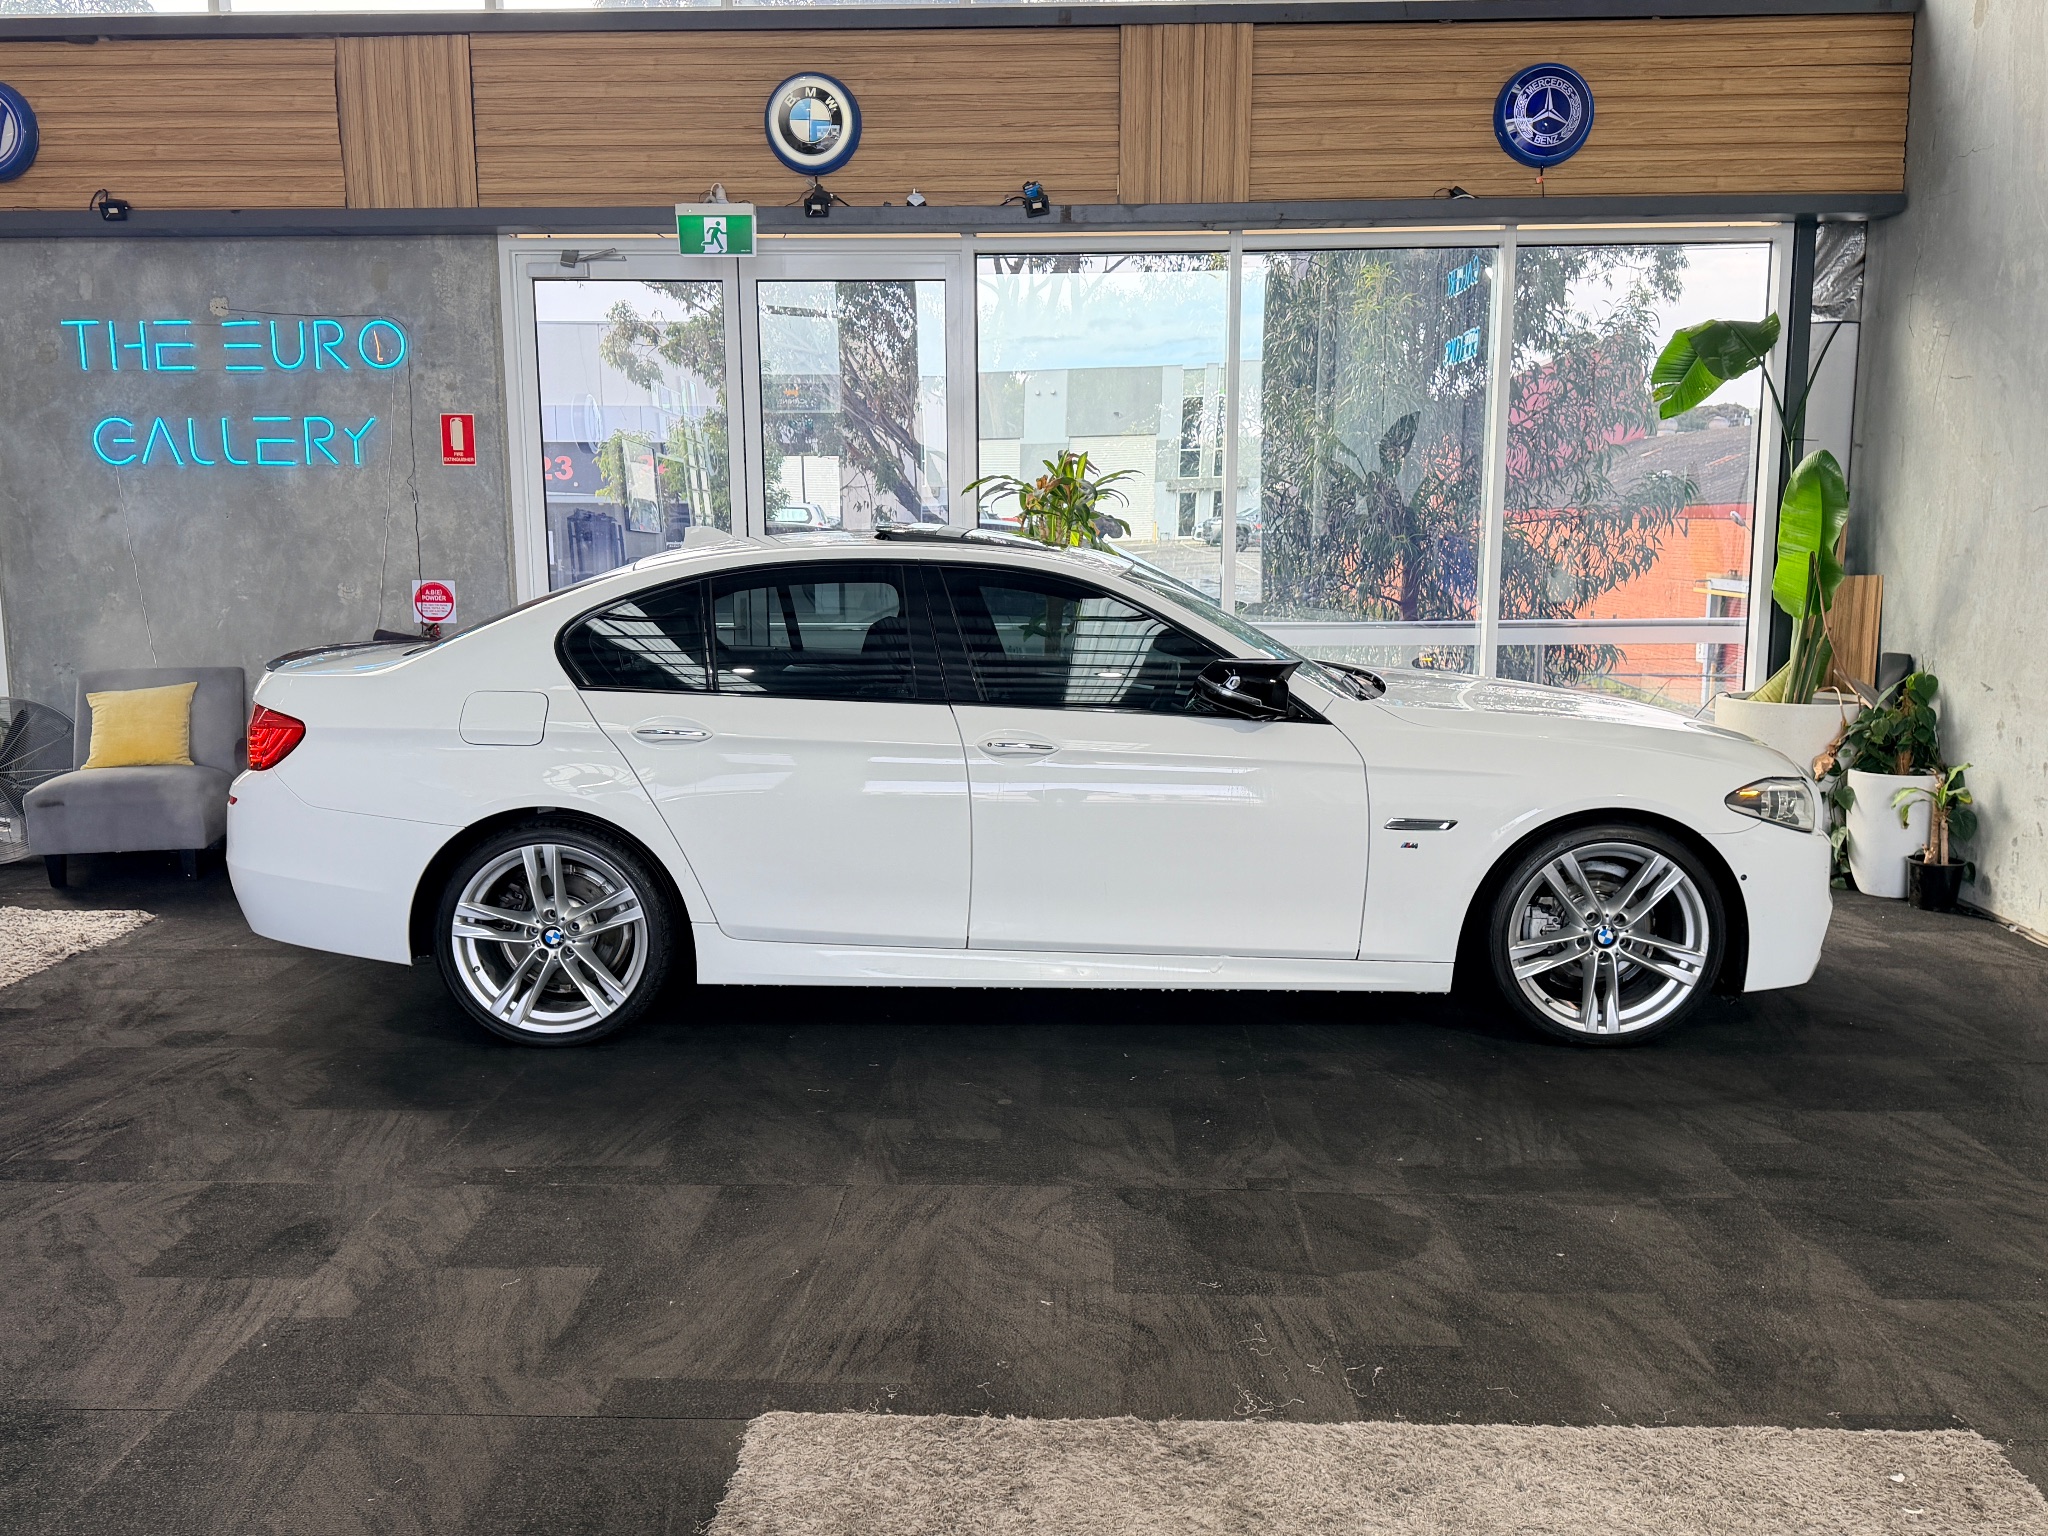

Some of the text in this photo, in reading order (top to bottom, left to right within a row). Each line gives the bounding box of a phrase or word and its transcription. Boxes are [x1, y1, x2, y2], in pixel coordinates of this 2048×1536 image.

[783, 86, 838, 110] BMW
[1525, 78, 1573, 96] MERCEDES
[1533, 135, 1560, 145] BENZ
[60, 319, 407, 371] THE EURO
[92, 415, 376, 466] GALLERY
